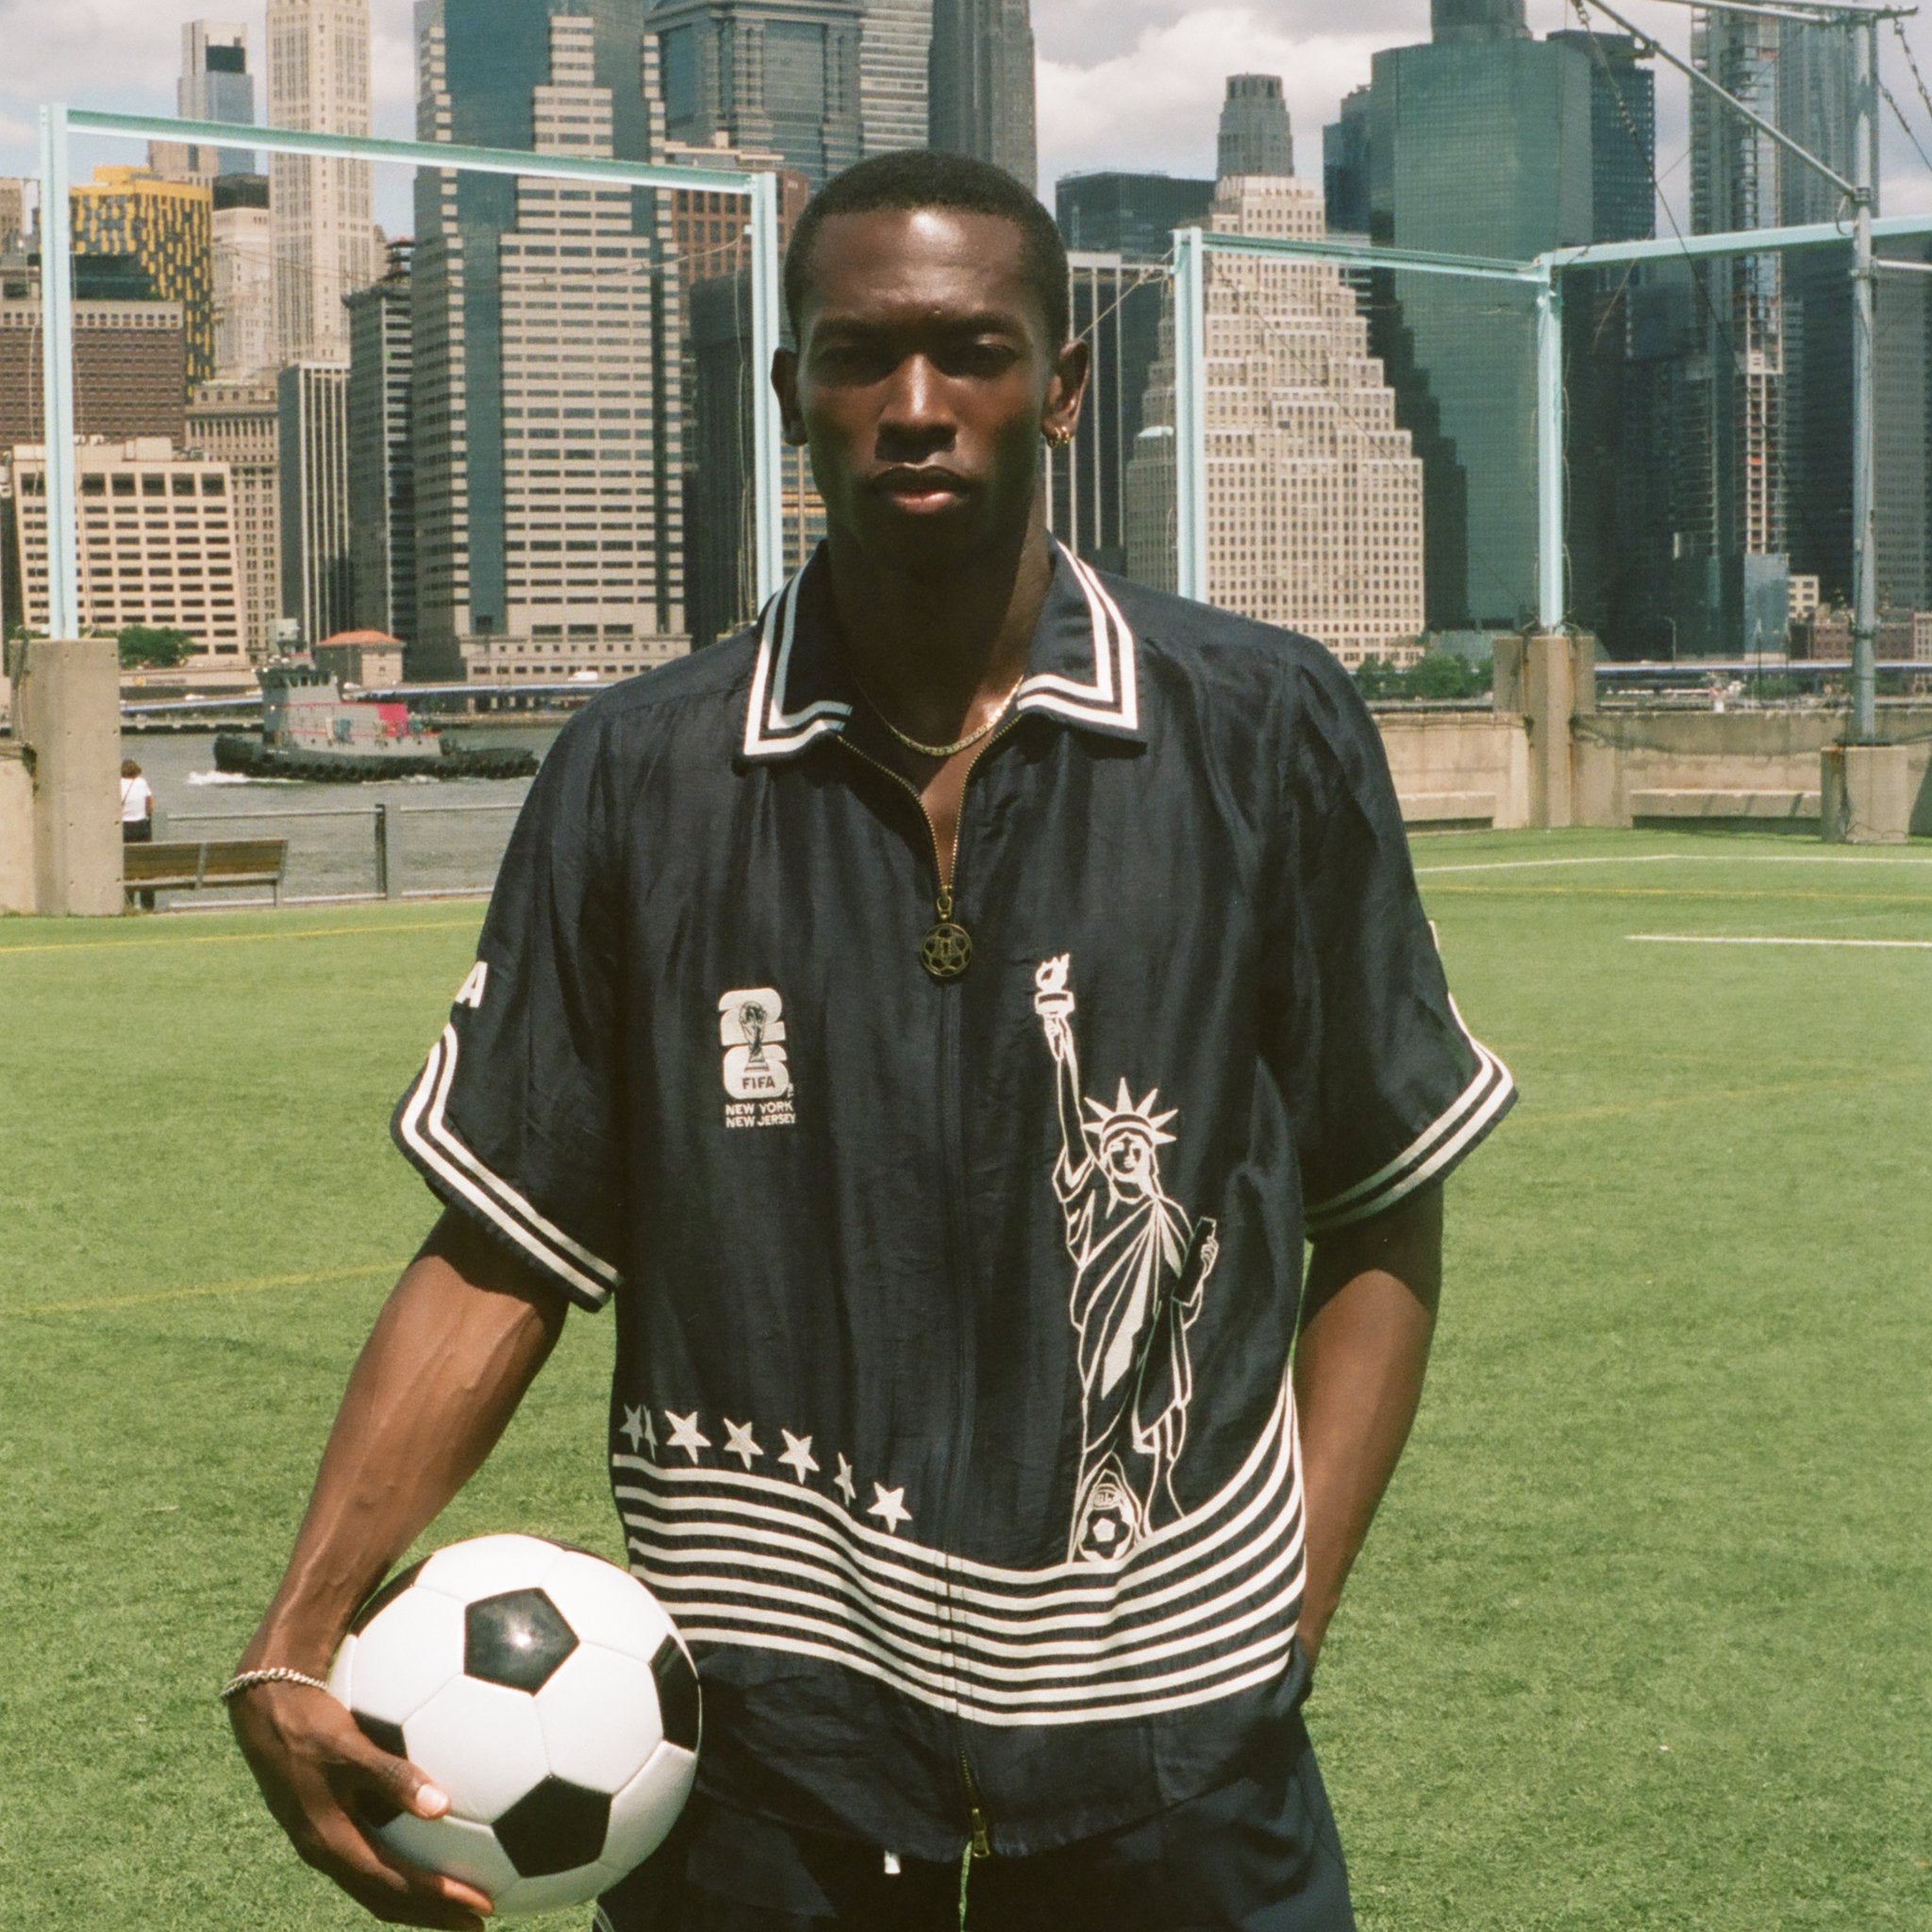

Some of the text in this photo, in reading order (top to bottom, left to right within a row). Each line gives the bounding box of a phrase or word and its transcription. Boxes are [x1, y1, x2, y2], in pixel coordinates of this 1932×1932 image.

[741, 1075, 776, 1091] FIFA
[724, 1100, 794, 1116] NEW YORK
[725, 1112, 796, 1128] NEW JERSEY
